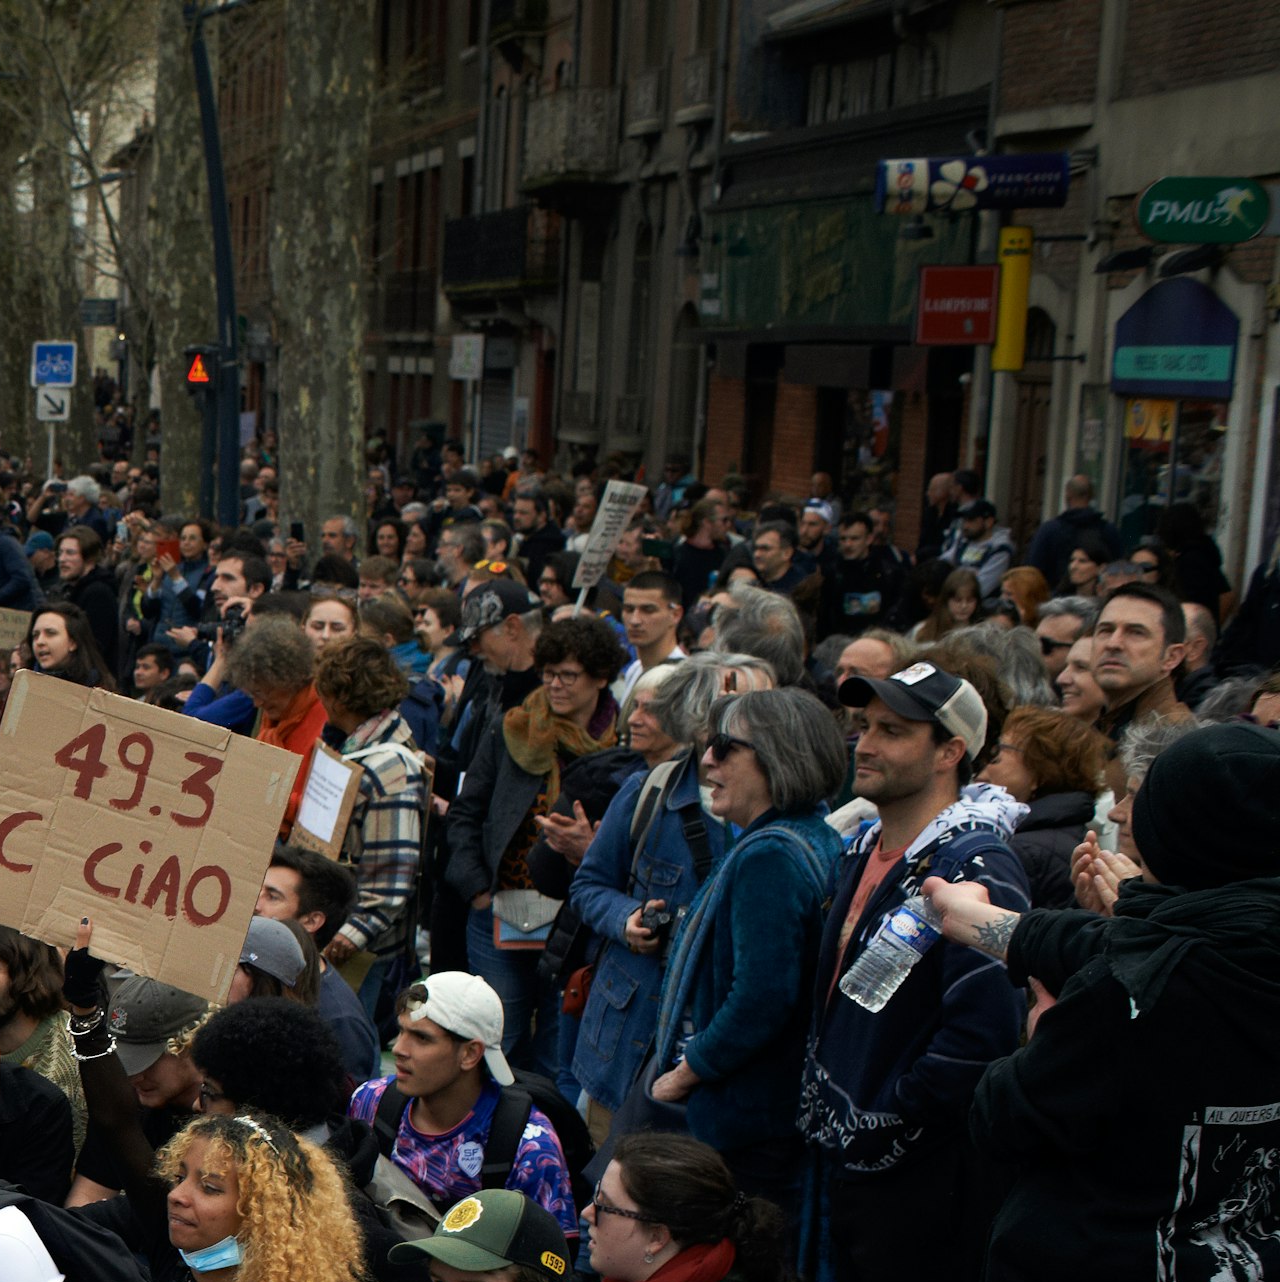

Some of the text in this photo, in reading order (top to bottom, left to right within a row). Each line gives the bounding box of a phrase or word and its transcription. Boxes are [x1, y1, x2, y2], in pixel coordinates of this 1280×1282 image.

[1147, 200, 1213, 224] PMU
[55, 722, 224, 828] 49.3
[1228, 1107, 1273, 1123] QUEERS
[544, 1253, 565, 1273] 1592
